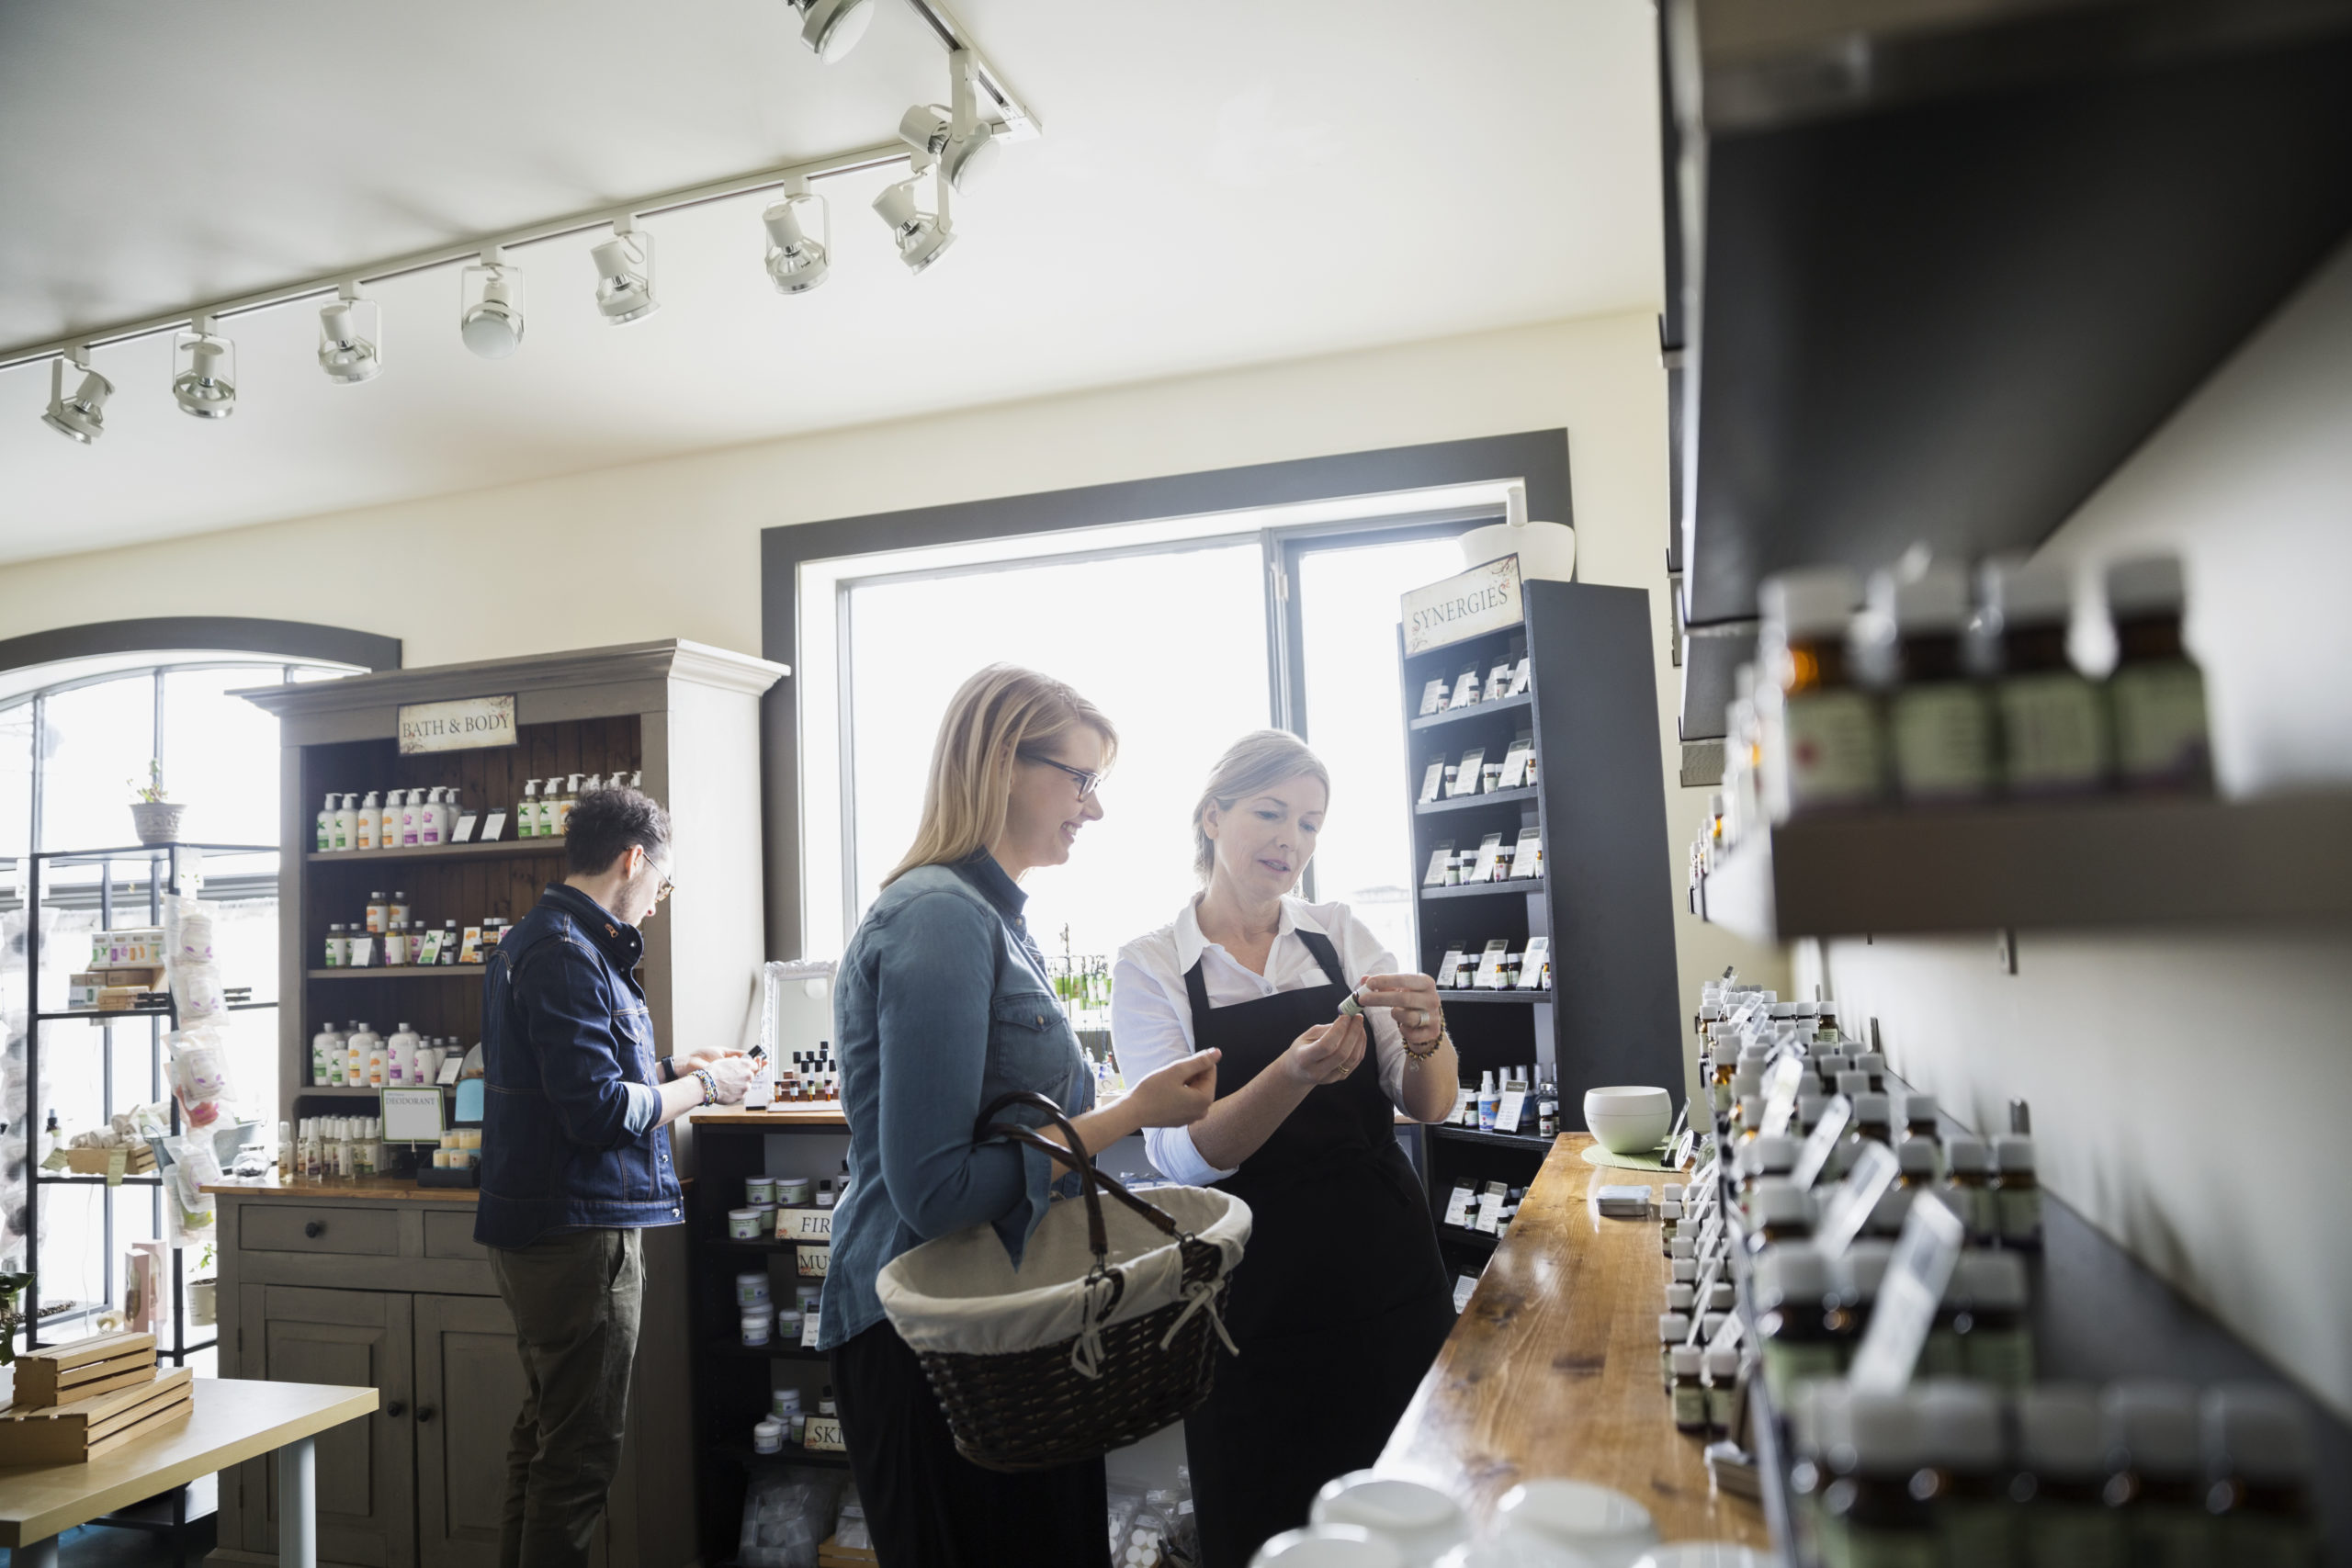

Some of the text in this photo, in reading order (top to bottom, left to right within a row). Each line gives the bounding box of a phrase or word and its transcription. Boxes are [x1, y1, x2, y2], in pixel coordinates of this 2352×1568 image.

[1413, 584, 1508, 631] SYNERGIES
[403, 714, 508, 738] BATH & BODY
[386, 1097, 435, 1105] DEODORANT
[801, 1217, 831, 1234] FIR
[799, 1255, 831, 1270] MU
[814, 1426, 845, 1444] SKI
